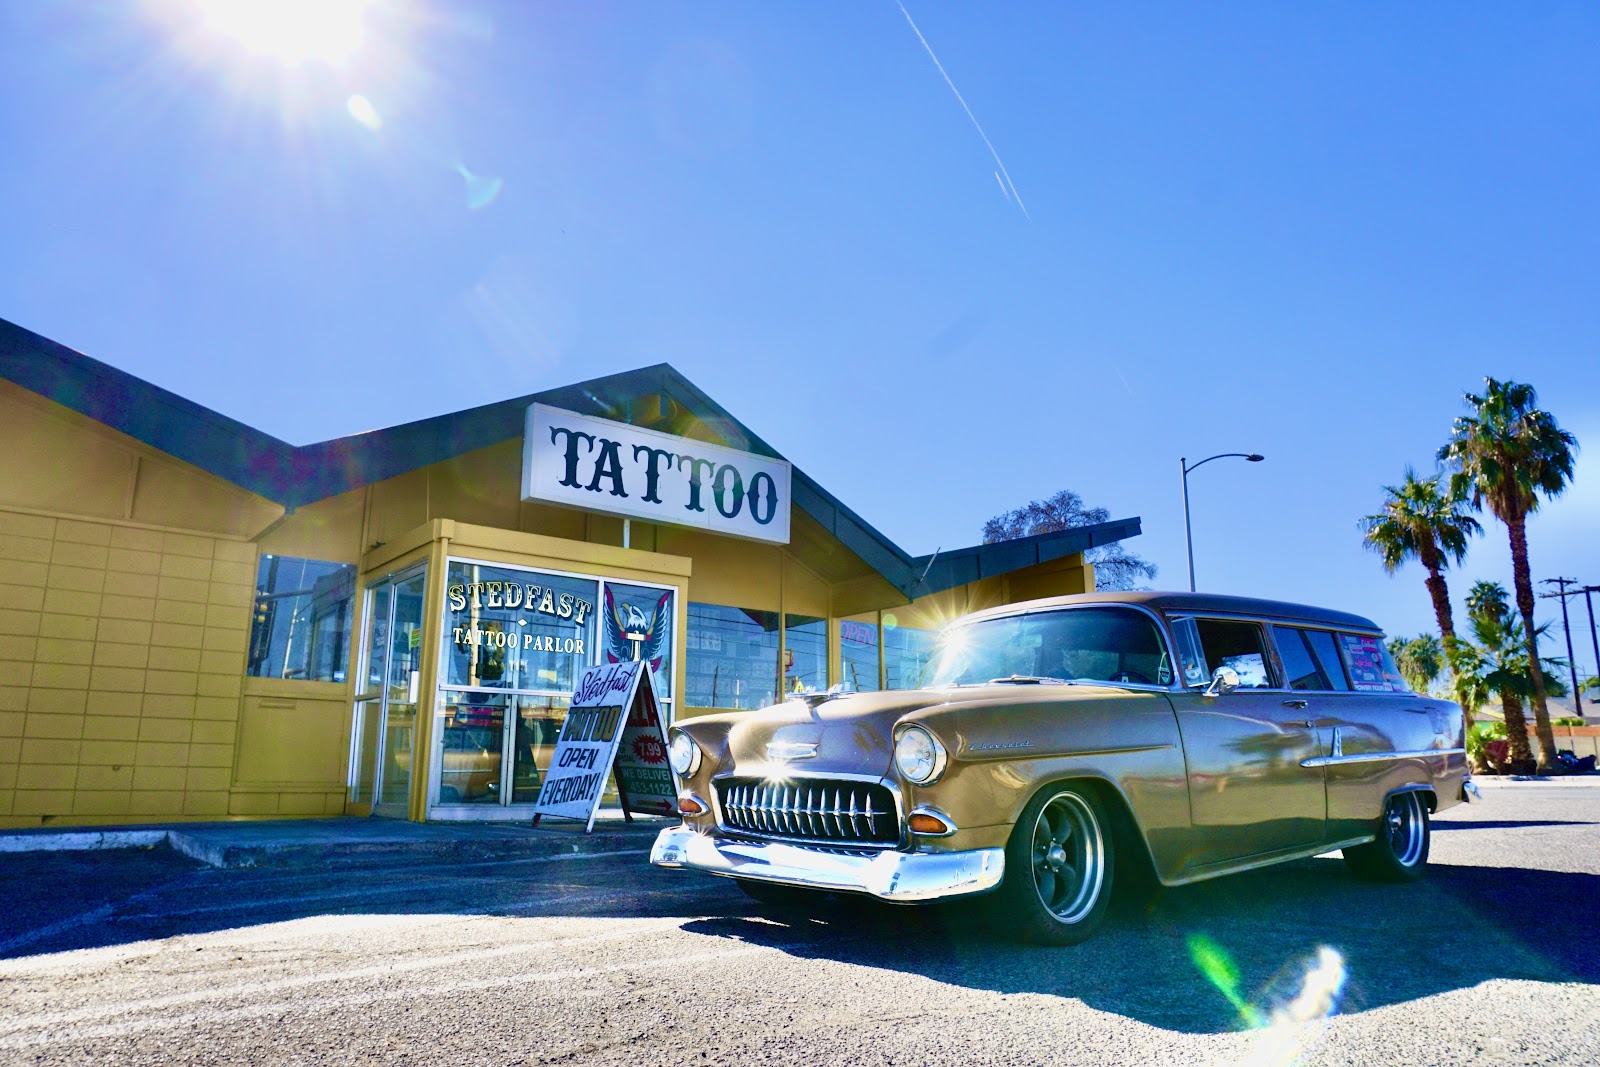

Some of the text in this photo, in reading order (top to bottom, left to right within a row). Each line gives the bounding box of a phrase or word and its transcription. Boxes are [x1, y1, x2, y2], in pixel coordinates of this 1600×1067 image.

[549, 426, 778, 525] TATTOO
[449, 581, 592, 625] STEDFAST
[453, 628, 585, 655] TATTOO PARLOR
[841, 621, 875, 646] OPEN
[573, 664, 636, 706] Stedfast
[562, 705, 623, 742] TATTOO
[559, 748, 599, 769] OPEN
[638, 743, 662, 756] 7.99
[970, 741, 1034, 751] Chevrolet
[621, 768, 635, 778] WE
[540, 772, 601, 806] EVERYDAY!
[630, 782, 673, 795] 453-1122
